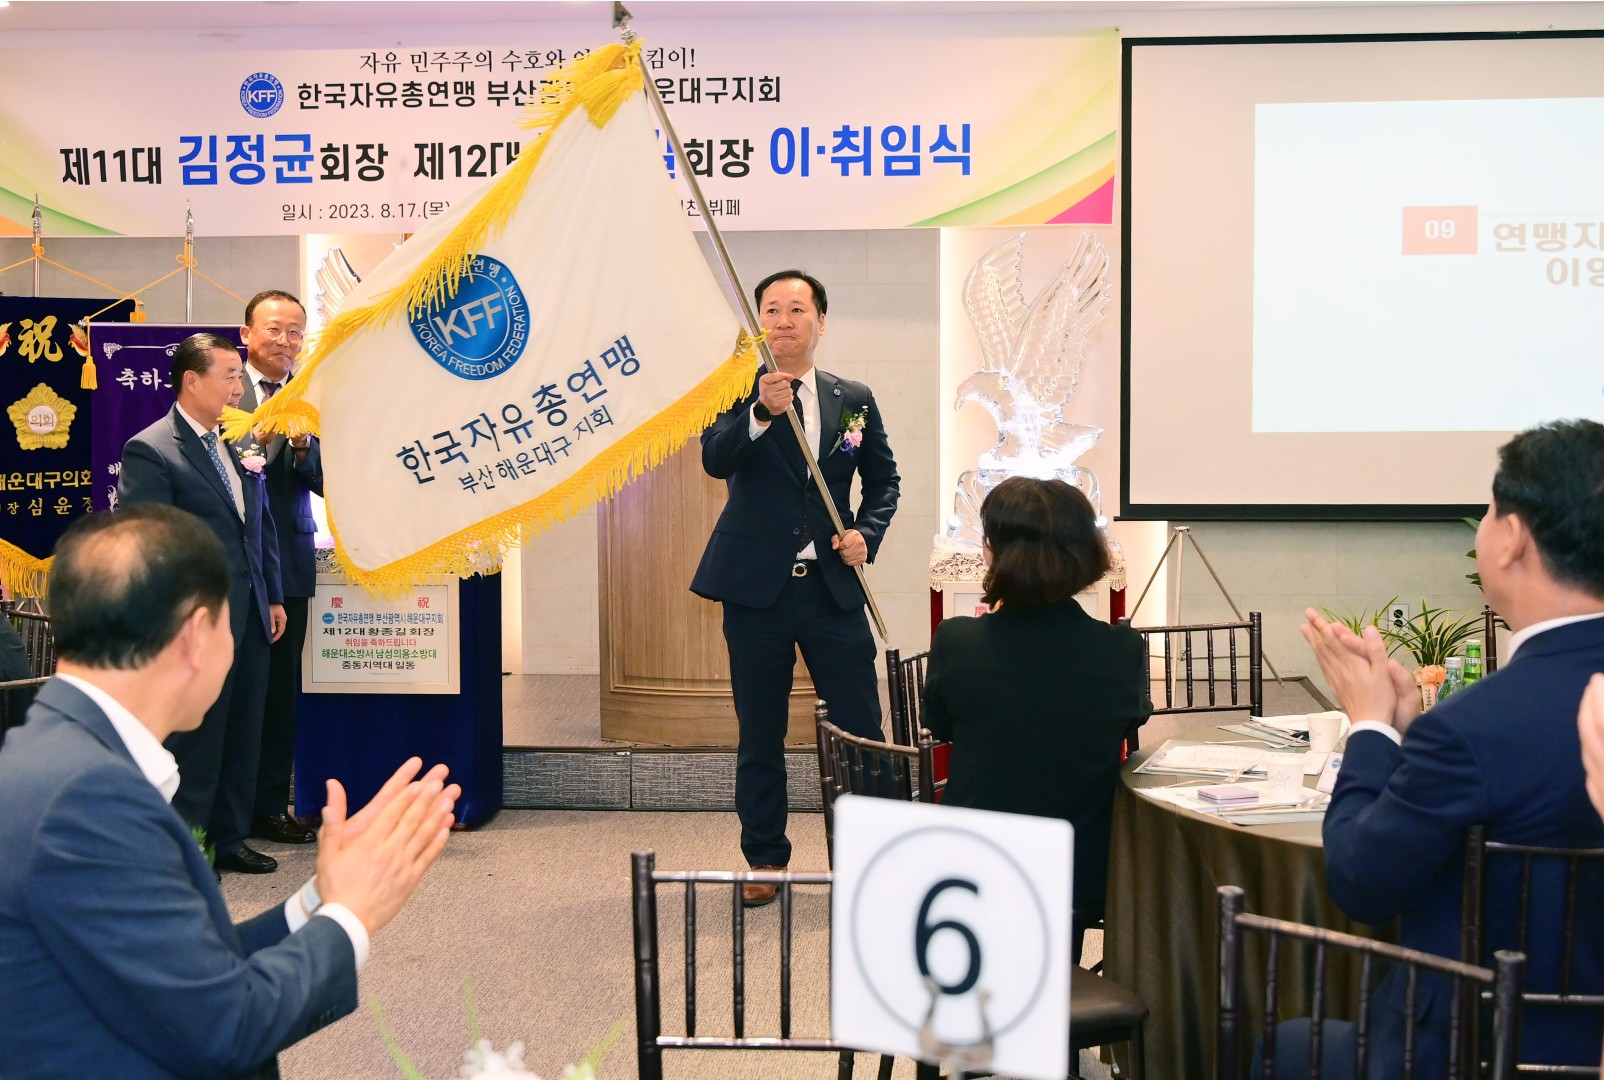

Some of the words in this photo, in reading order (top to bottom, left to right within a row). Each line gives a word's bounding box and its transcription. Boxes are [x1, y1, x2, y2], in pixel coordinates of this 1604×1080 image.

[360, 51, 402, 74] 자유
[410, 50, 493, 73] 민주주의
[501, 49, 566, 70] 수호와
[646, 47, 695, 70] 킴이!
[247, 90, 277, 103] KFF
[298, 81, 477, 109] 한국자유총연맹
[644, 75, 781, 104] 운대구지회
[60, 146, 163, 186] 제11대
[413, 140, 521, 181] 제12대
[768, 123, 972, 178] 이·취임식
[282, 203, 312, 221] 일시
[328, 203, 375, 220] 2023.
[709, 199, 741, 217] 뷔페
[1425, 219, 1456, 239] 09
[432, 291, 503, 346] KFF
[18, 315, 64, 364] 祝
[415, 322, 449, 362] KOREA
[447, 356, 506, 376] FREEDOM
[501, 284, 527, 363] FEDERATION
[29, 413, 56, 428] 의회
[395, 335, 641, 485] 한국자유총연맹
[331, 596, 344, 609] 慶
[417, 596, 431, 609] 祝
[375, 612, 406, 625] 부산광역시
[322, 627, 366, 636] 제12대
[409, 627, 436, 636] 회장
[344, 638, 369, 647] 취임을
[370, 638, 417, 647] 축하드립니다
[321, 648, 374, 659] 해운대소방서
[375, 648, 437, 659] 남성의용소방대
[341, 660, 393, 670] 중동지역대
[395, 660, 416, 670] 일동
[914, 877, 983, 996] 6
